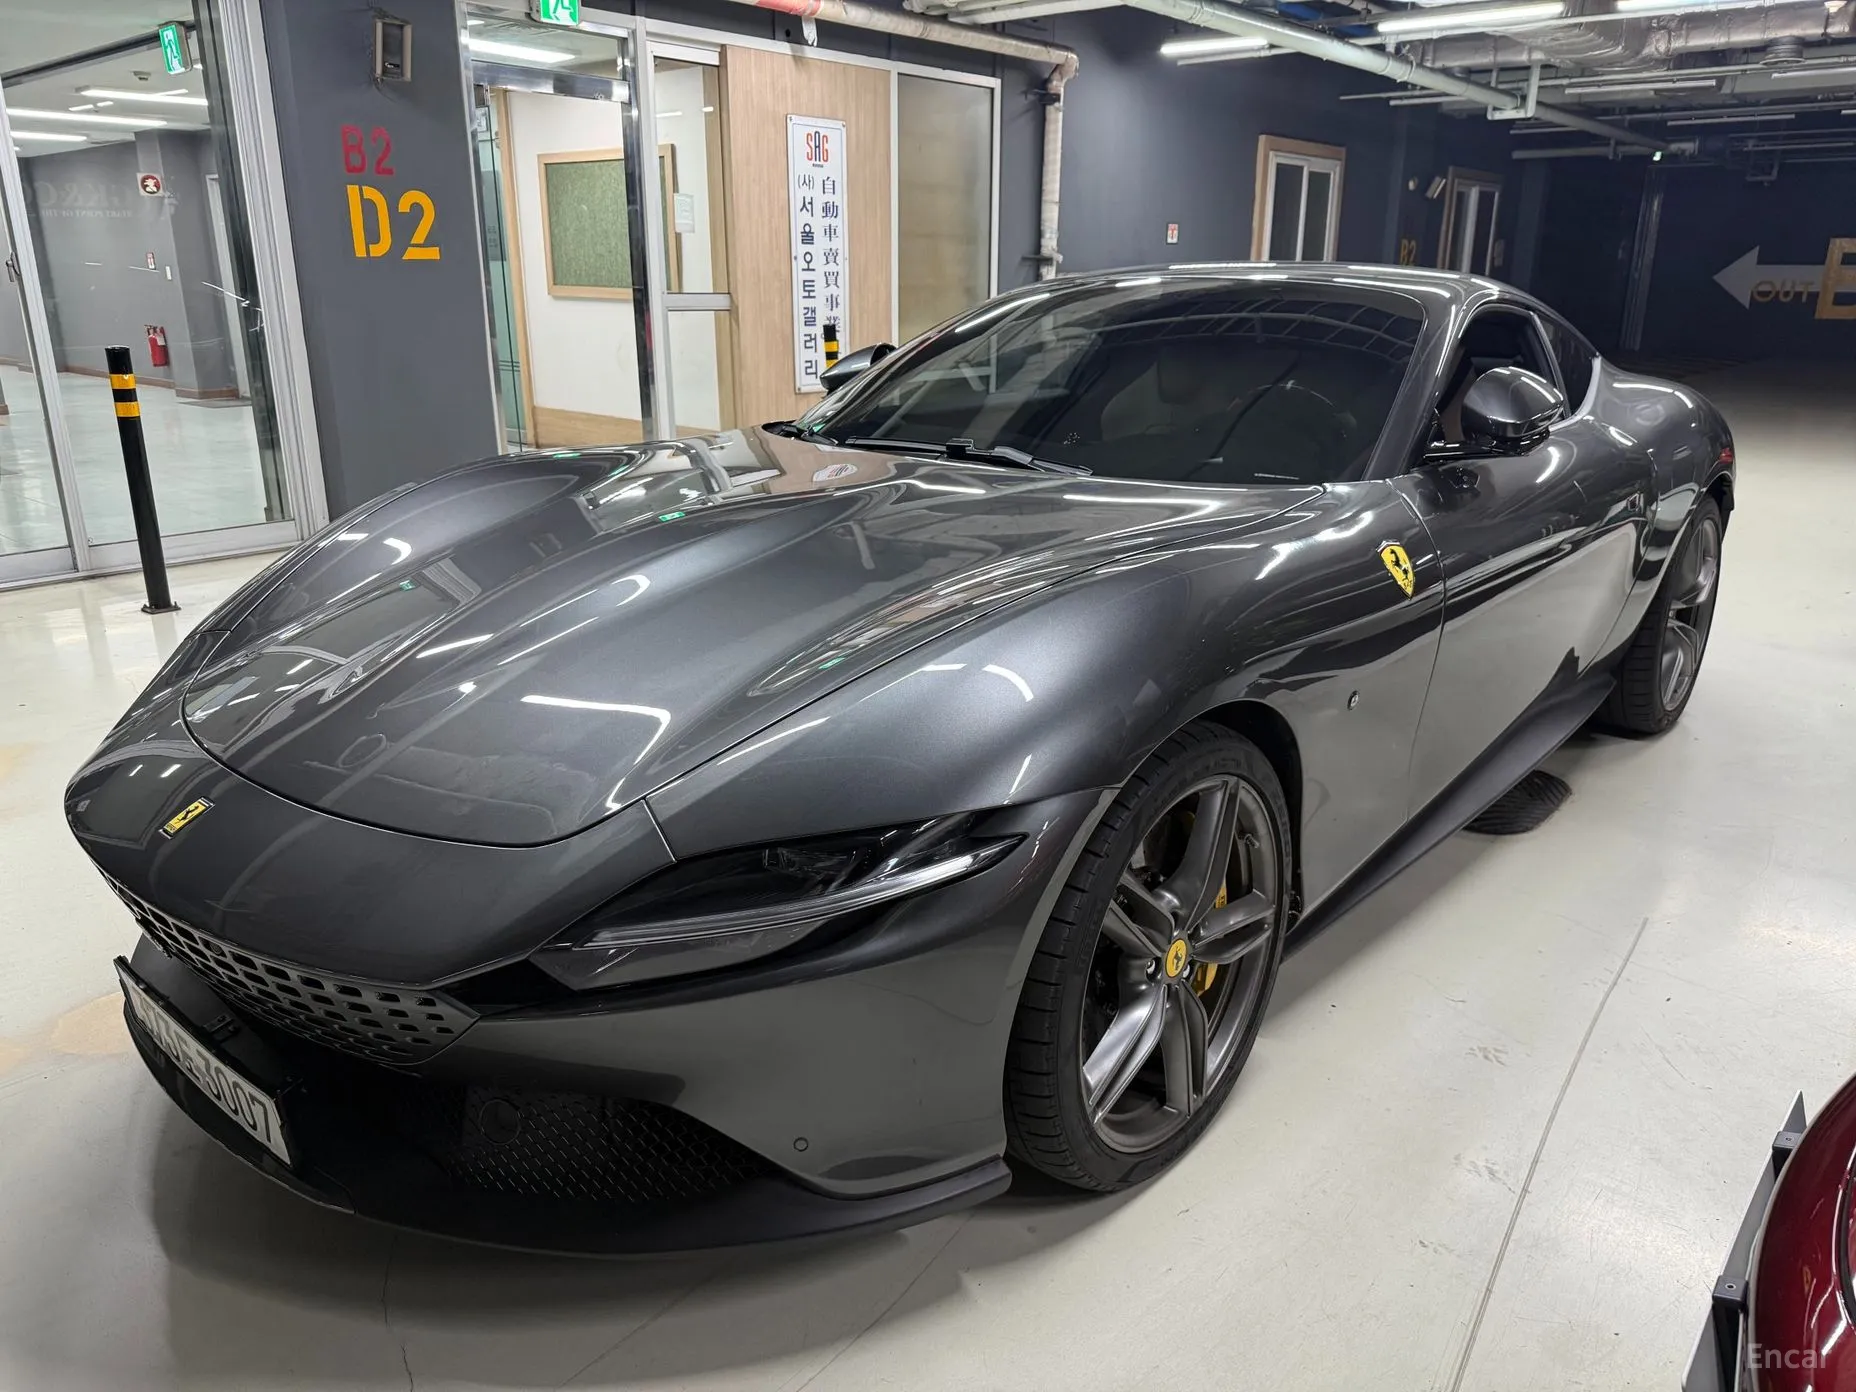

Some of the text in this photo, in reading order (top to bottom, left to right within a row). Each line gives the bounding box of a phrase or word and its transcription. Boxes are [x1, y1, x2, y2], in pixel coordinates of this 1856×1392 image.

[342, 125, 395, 176] B2
[806, 130, 829, 163] SAG
[346, 184, 440, 260] D2
[1753, 280, 1815, 303] OUT
[197, 1049, 272, 1143] 3007
